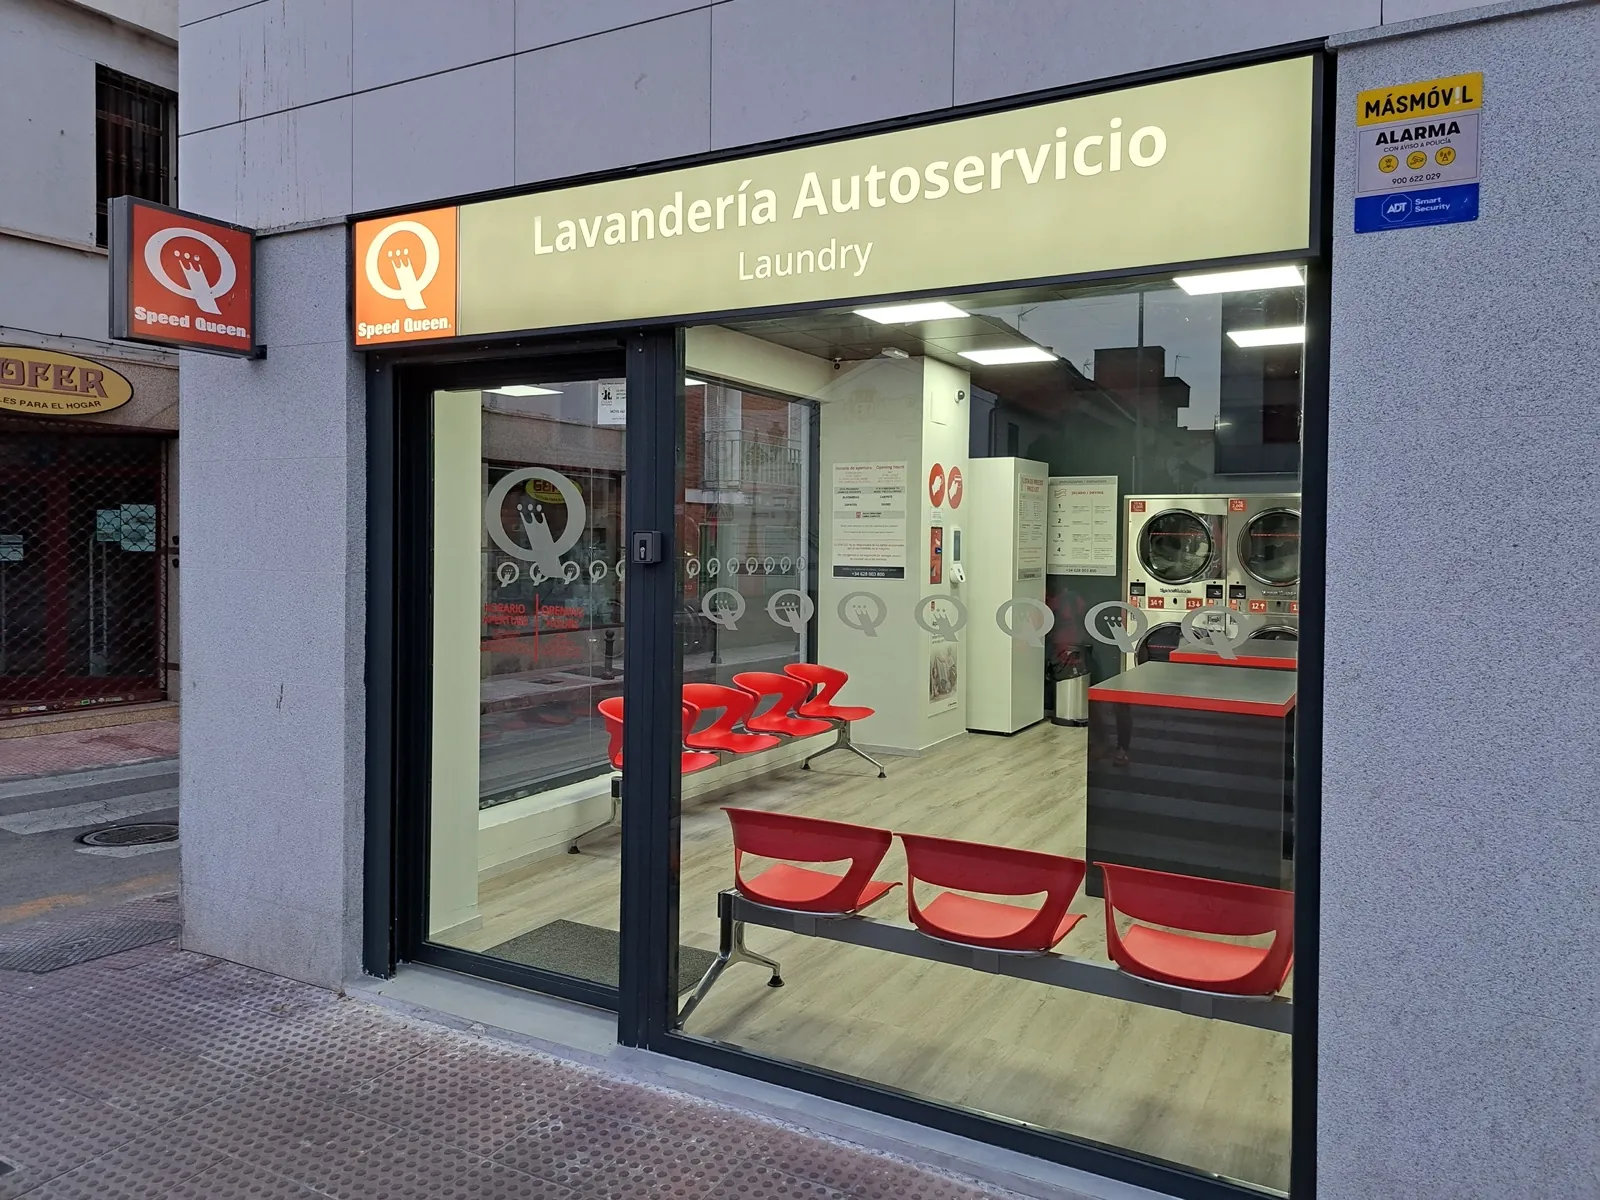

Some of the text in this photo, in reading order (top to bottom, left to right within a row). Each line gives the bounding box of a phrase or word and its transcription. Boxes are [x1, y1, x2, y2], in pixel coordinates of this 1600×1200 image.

[1375, 121, 1461, 146] ALARMA
[534, 117, 1168, 255] Lavandería Autoservicio
[1387, 202, 1407, 214] ADT
[1415, 197, 1441, 205] Smart
[1415, 203, 1450, 213] Security
[738, 237, 873, 281] Laundry
[134, 306, 247, 338] Speed Queen
[358, 317, 448, 339] Speed Queen
[19, 400, 48, 408] PARA
[66, 400, 101, 409] HOGAR
